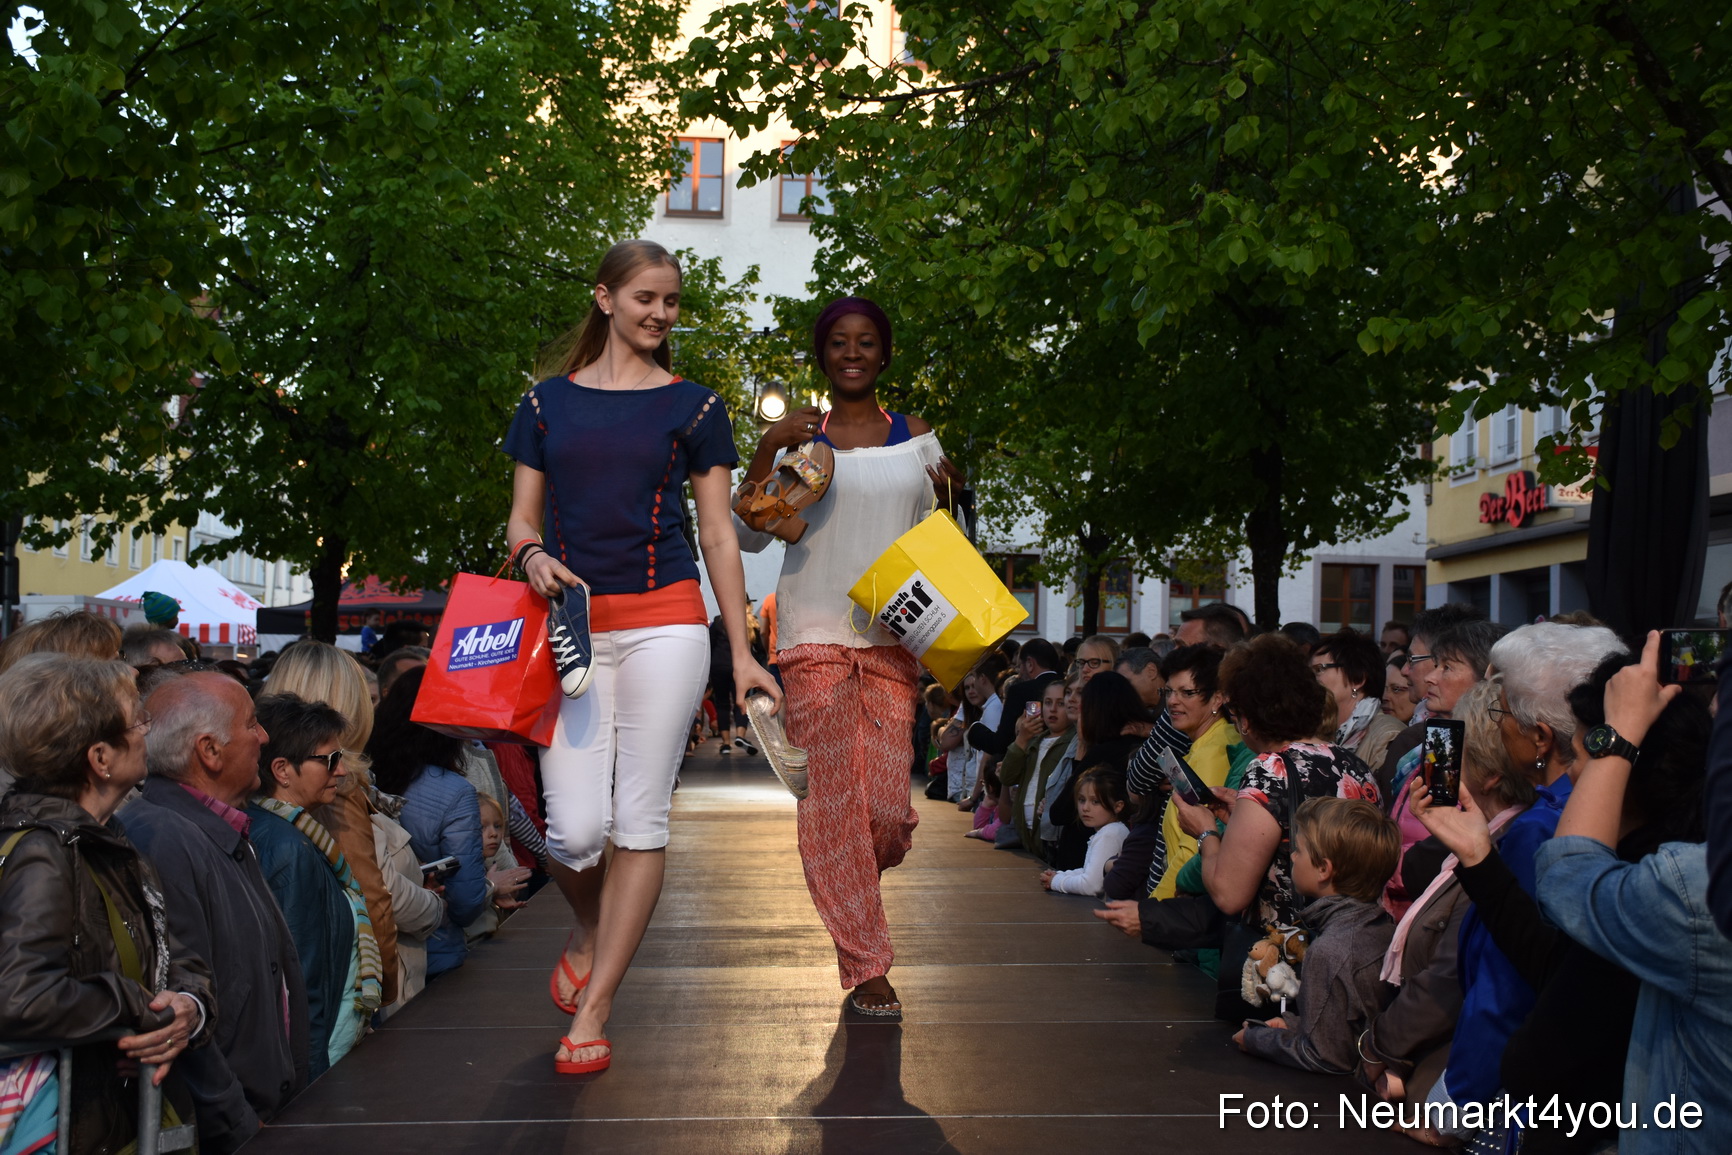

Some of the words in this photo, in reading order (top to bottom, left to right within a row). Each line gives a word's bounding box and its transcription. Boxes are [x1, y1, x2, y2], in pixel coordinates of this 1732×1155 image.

[1479, 492, 1504, 524] Der
[880, 591, 910, 623] Schuh
[924, 604, 941, 624] SCHUH
[451, 618, 524, 658] Arbell
[448, 661, 474, 670] Neumarkt
[477, 655, 511, 666] Kirchengasse
